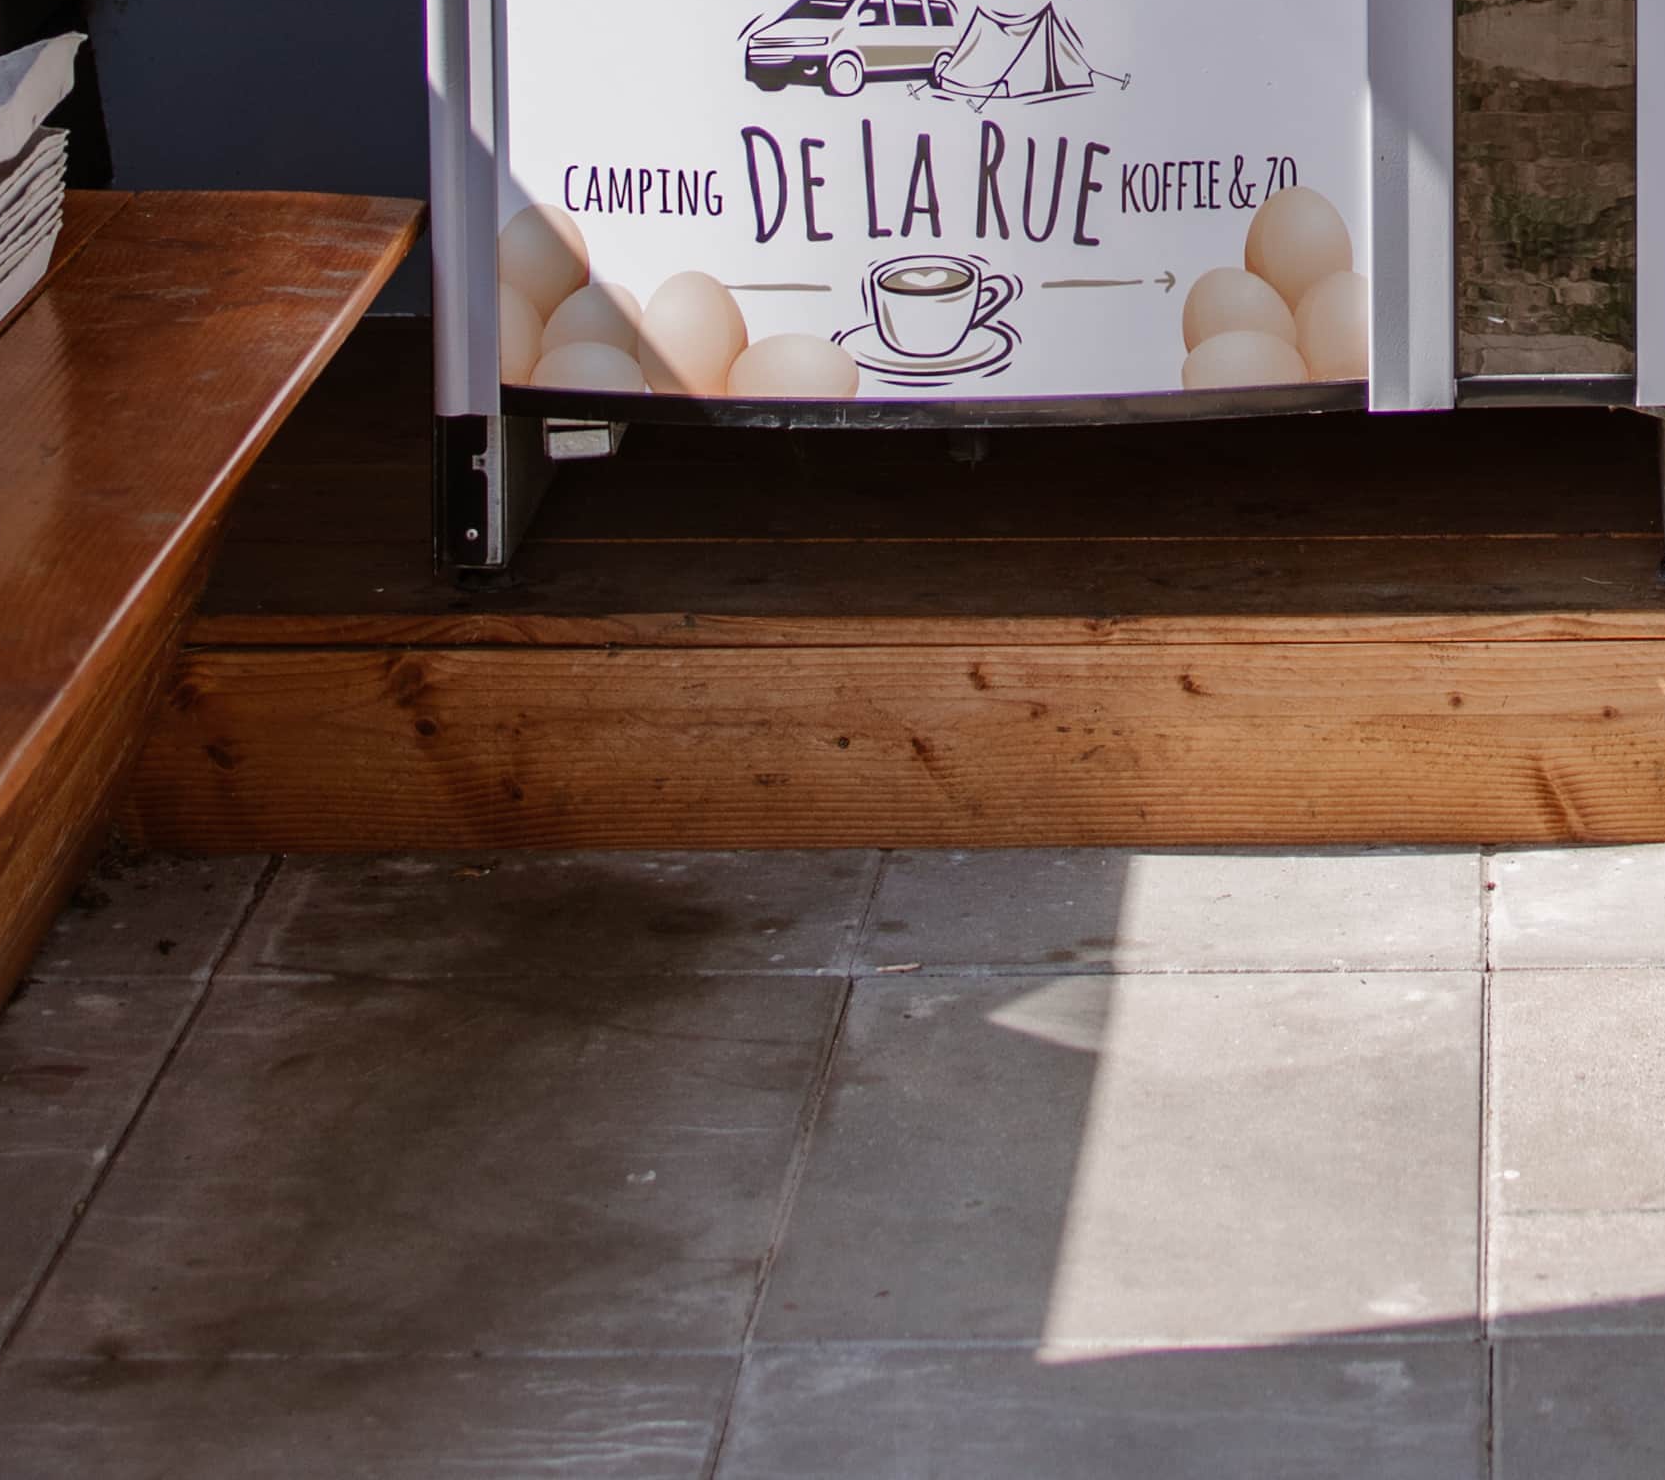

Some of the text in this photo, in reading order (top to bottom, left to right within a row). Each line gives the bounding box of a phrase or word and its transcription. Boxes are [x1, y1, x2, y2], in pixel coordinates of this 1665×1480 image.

[564, 164, 724, 217] CAMPING
[740, 126, 830, 245] DE
[861, 119, 943, 240] LA
[975, 119, 1111, 247] RUE
[1121, 160, 1222, 213] KOFFIE
[1228, 154, 1257, 210] &
